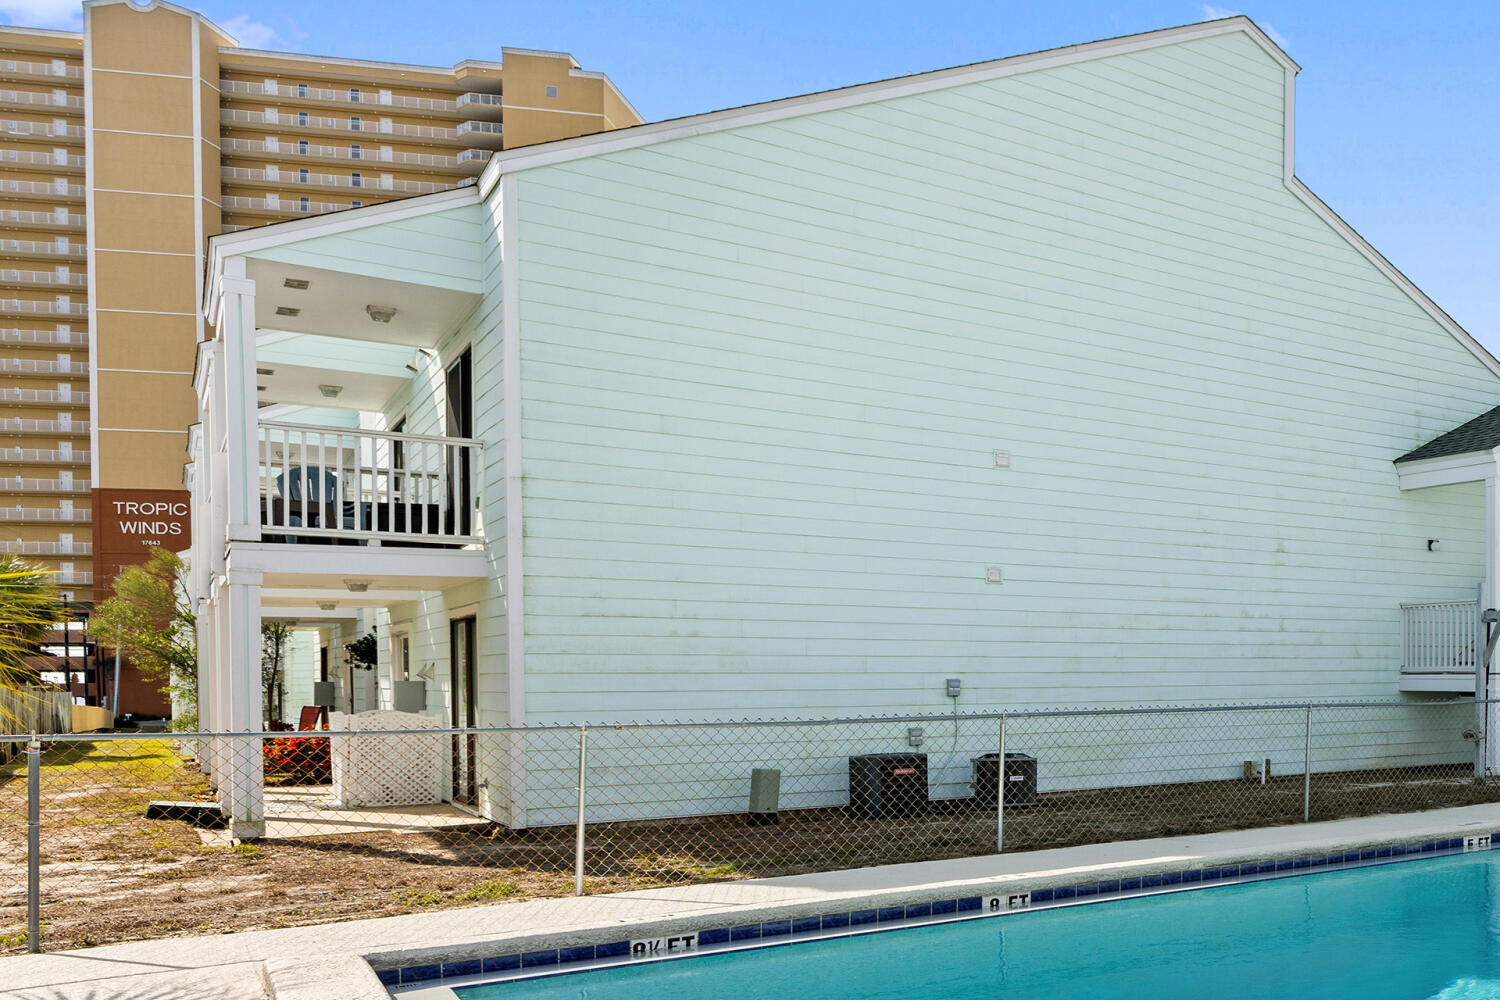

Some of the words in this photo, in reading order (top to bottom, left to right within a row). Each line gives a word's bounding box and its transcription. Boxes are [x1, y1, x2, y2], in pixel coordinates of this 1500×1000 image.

[112, 501, 188, 516] TROPIC
[119, 521, 182, 535] WINDS
[1008, 894, 1029, 906] FT
[667, 935, 695, 949] FT
